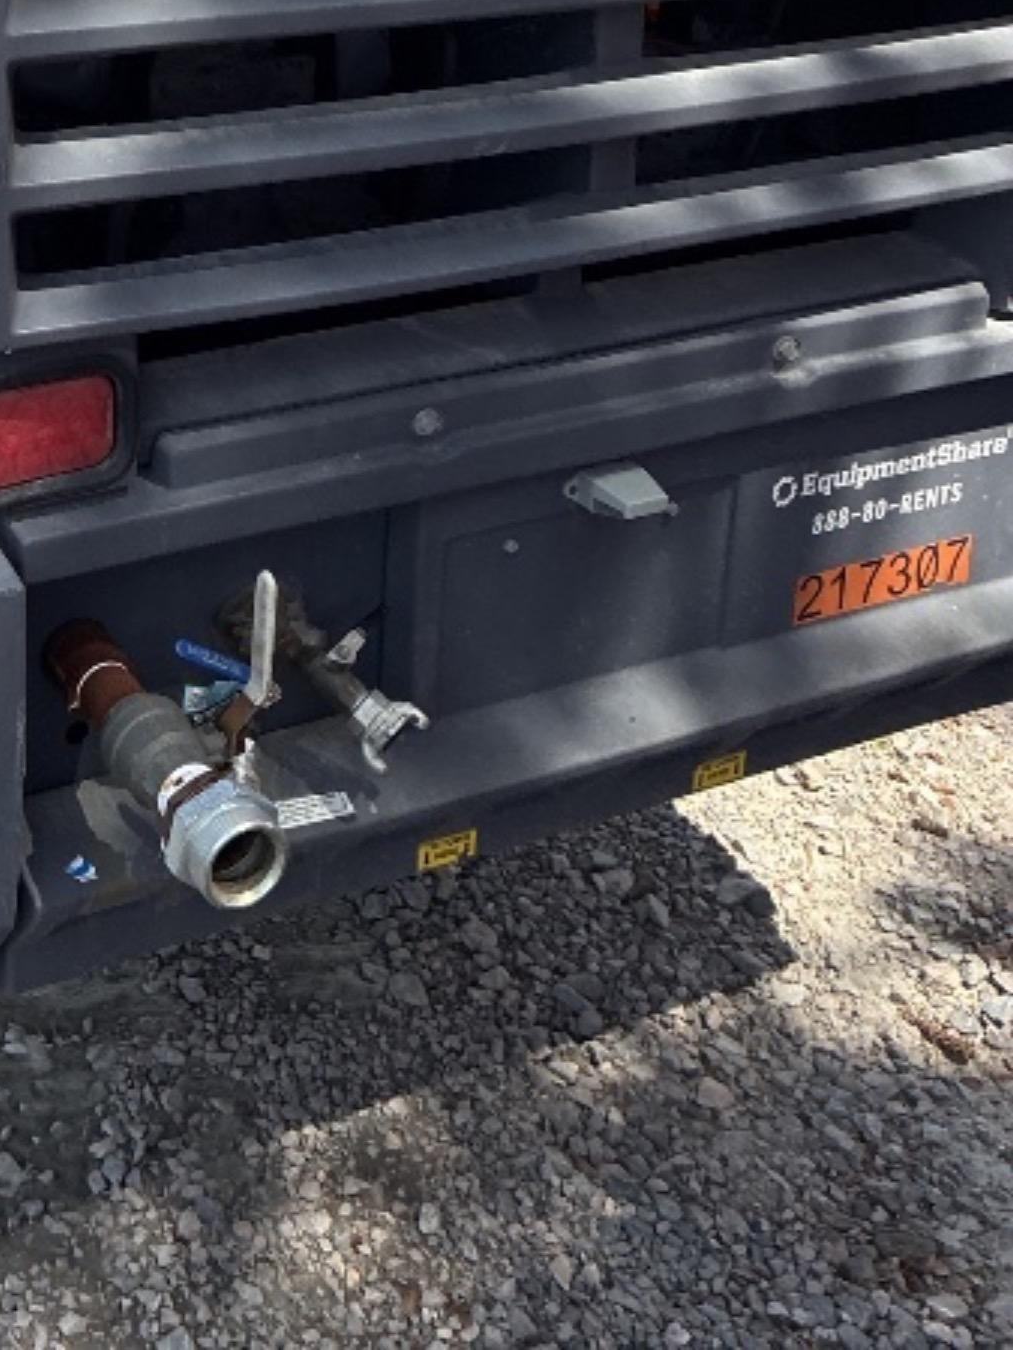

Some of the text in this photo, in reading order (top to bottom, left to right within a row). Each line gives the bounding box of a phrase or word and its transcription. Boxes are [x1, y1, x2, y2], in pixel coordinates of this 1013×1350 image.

[800, 435, 1008, 497] EquipmentShare
[811, 482, 964, 536] 888-80-RENTS
[796, 536, 970, 622] 217307
